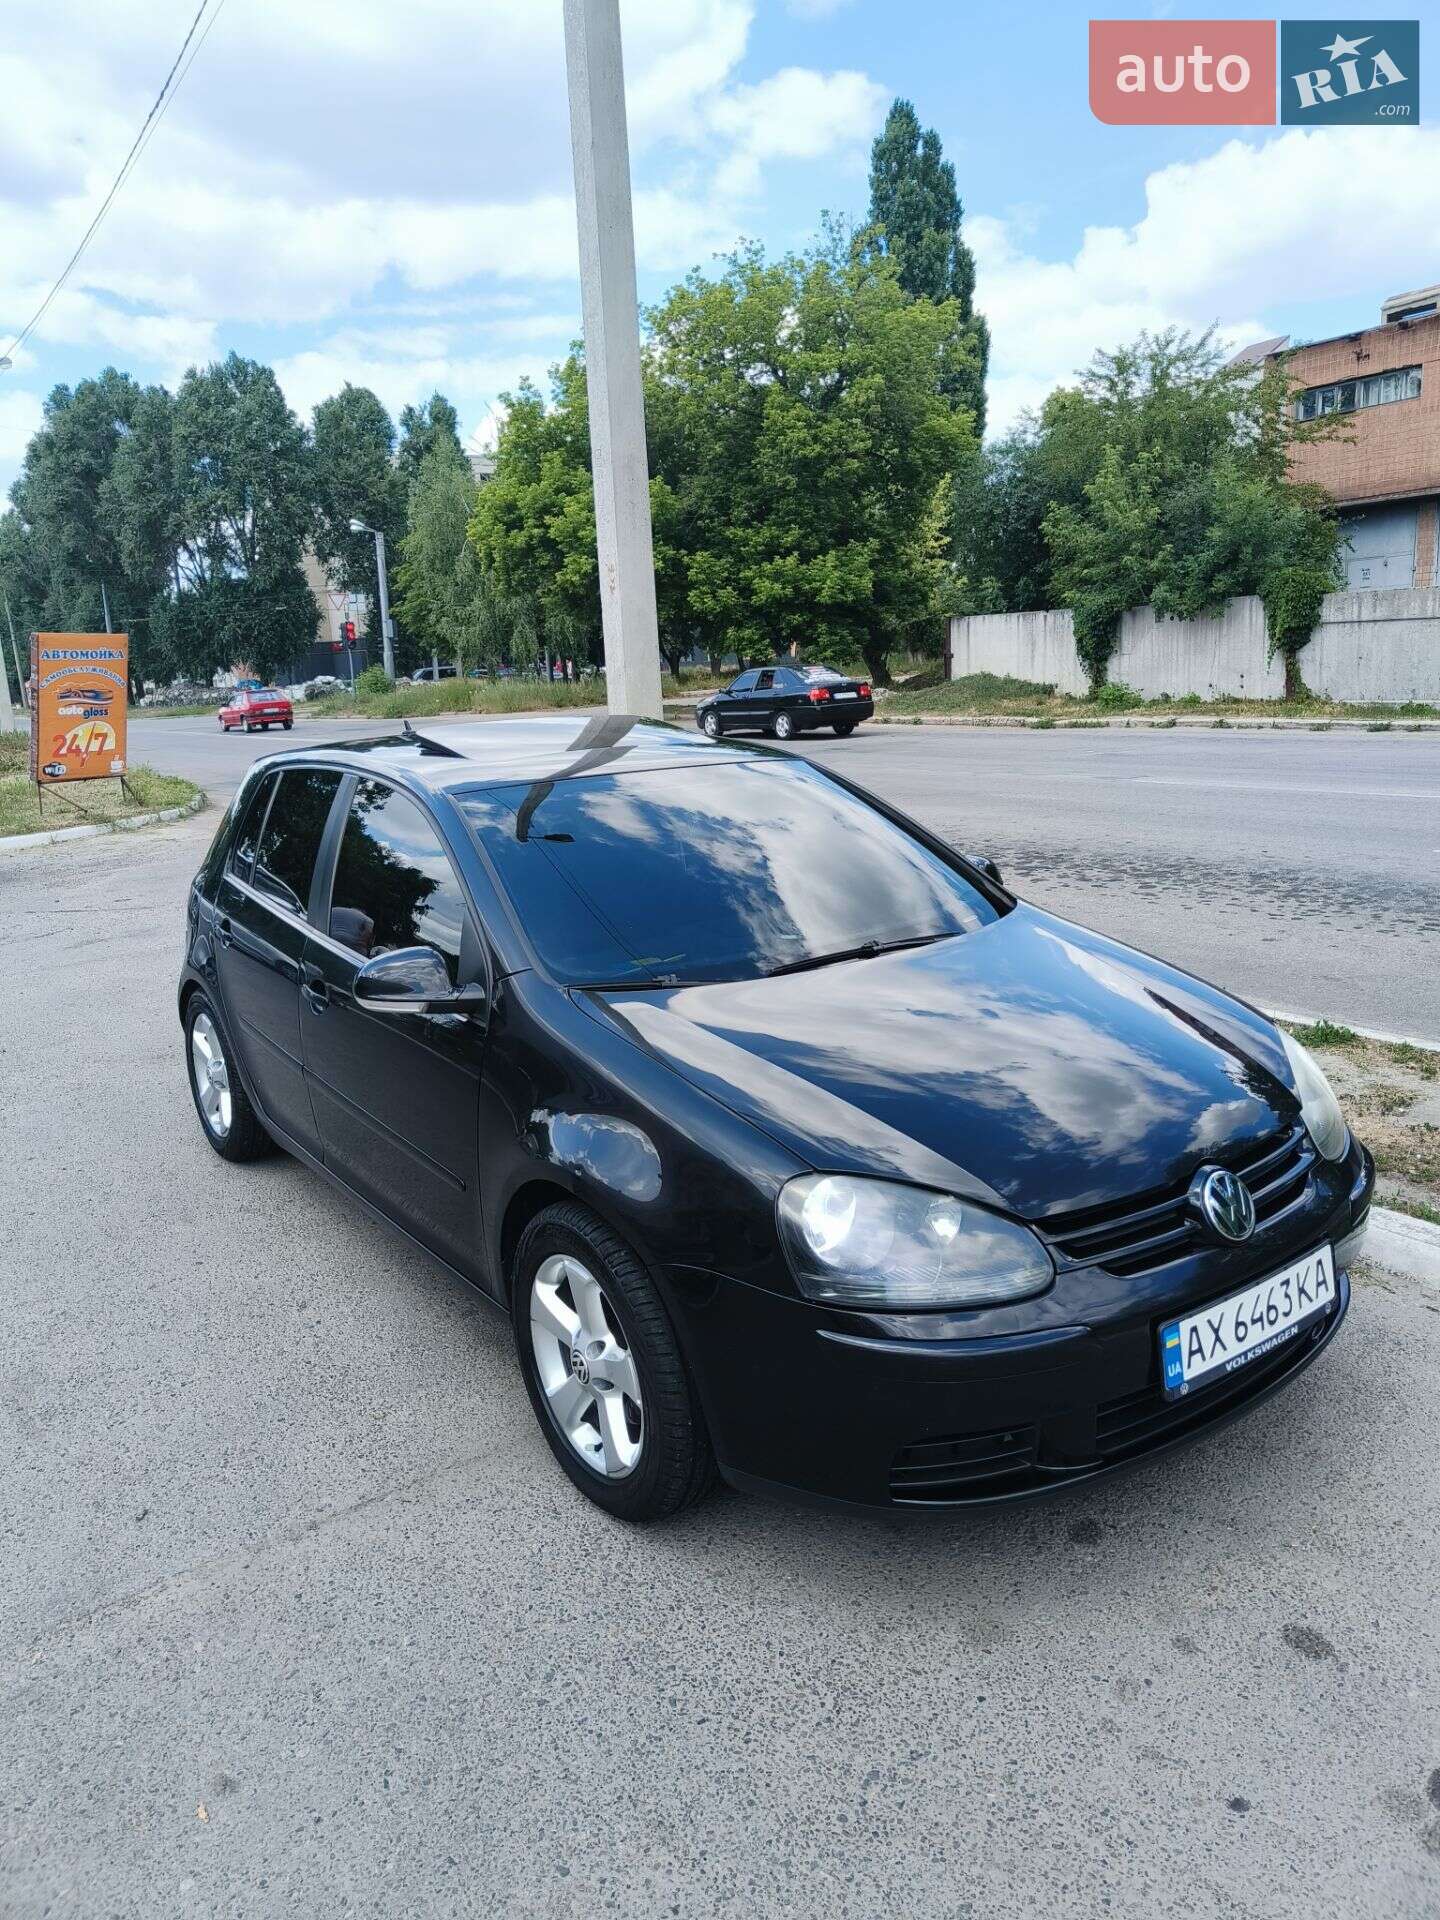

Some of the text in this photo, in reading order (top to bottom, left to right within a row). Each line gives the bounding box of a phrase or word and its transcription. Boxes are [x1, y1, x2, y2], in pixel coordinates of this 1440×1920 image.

[41, 647, 125, 660] АВТОМОЙКА
[53, 722, 108, 768] 24/7
[1186, 1258, 1329, 1369] AX 6463 KA
[1168, 1361, 1182, 1377] UA
[1225, 1325, 1298, 1371] VOLKSWAGEN
